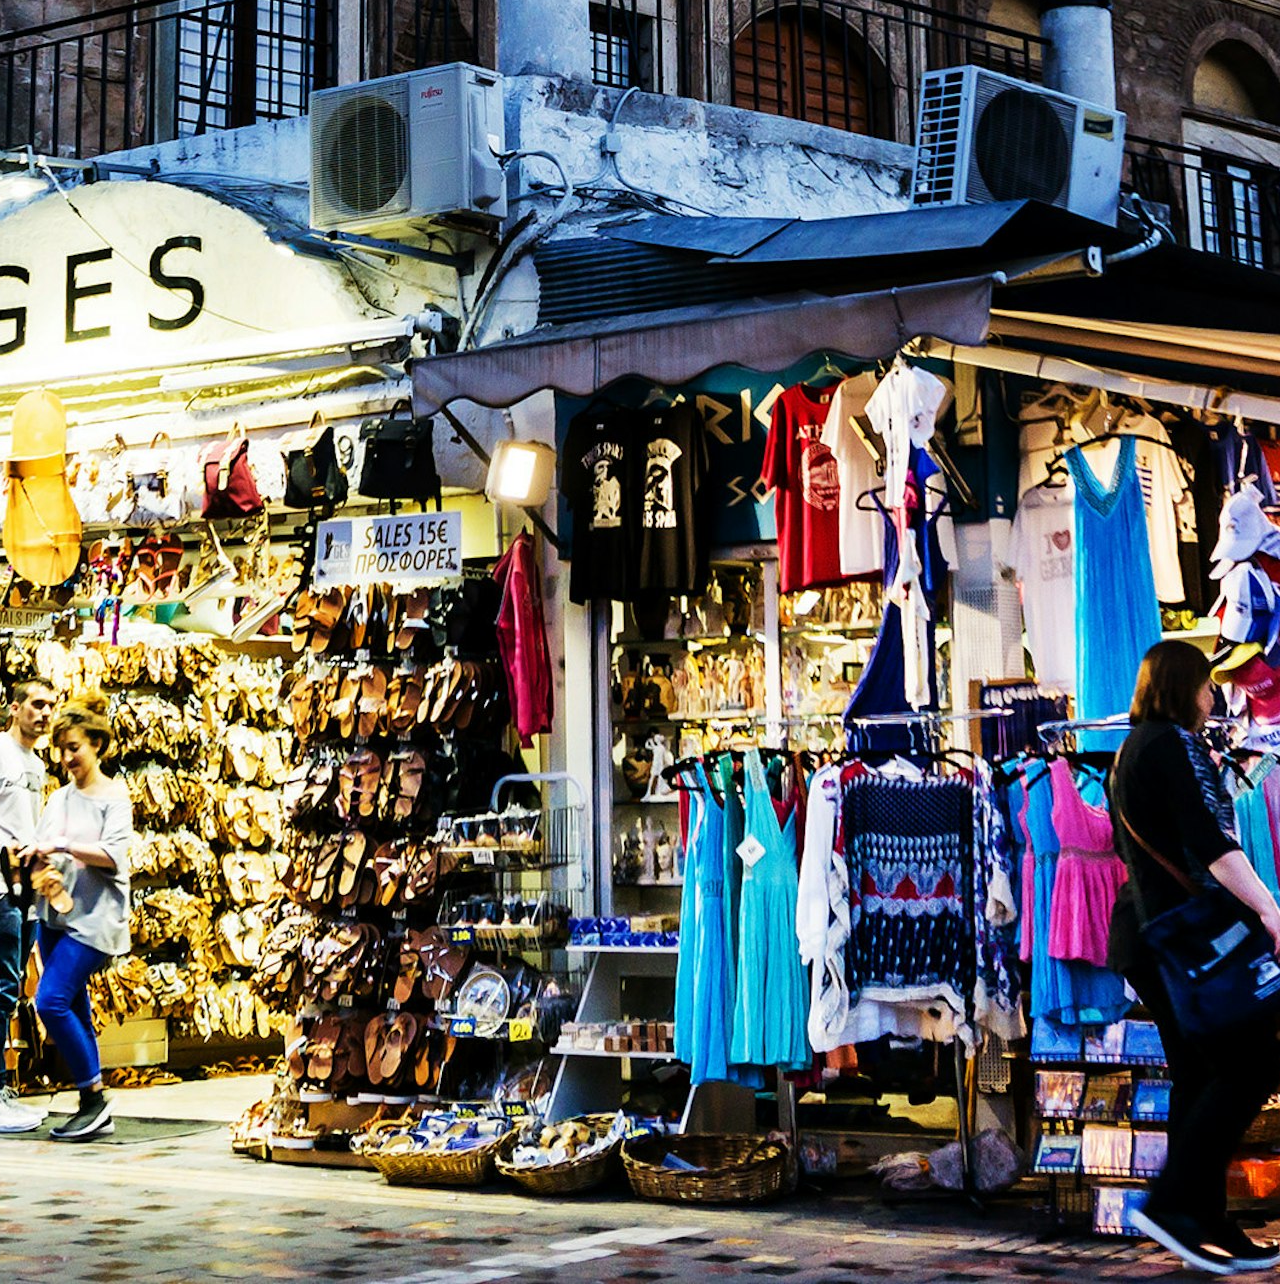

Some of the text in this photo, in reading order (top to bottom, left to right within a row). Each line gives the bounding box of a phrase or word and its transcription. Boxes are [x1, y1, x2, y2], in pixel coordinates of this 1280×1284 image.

[364, 520, 448, 549] SALES 15€
[333, 544, 351, 559] GES
[354, 548, 457, 575] ΠΡΟΣΦΟΡΕΣ
